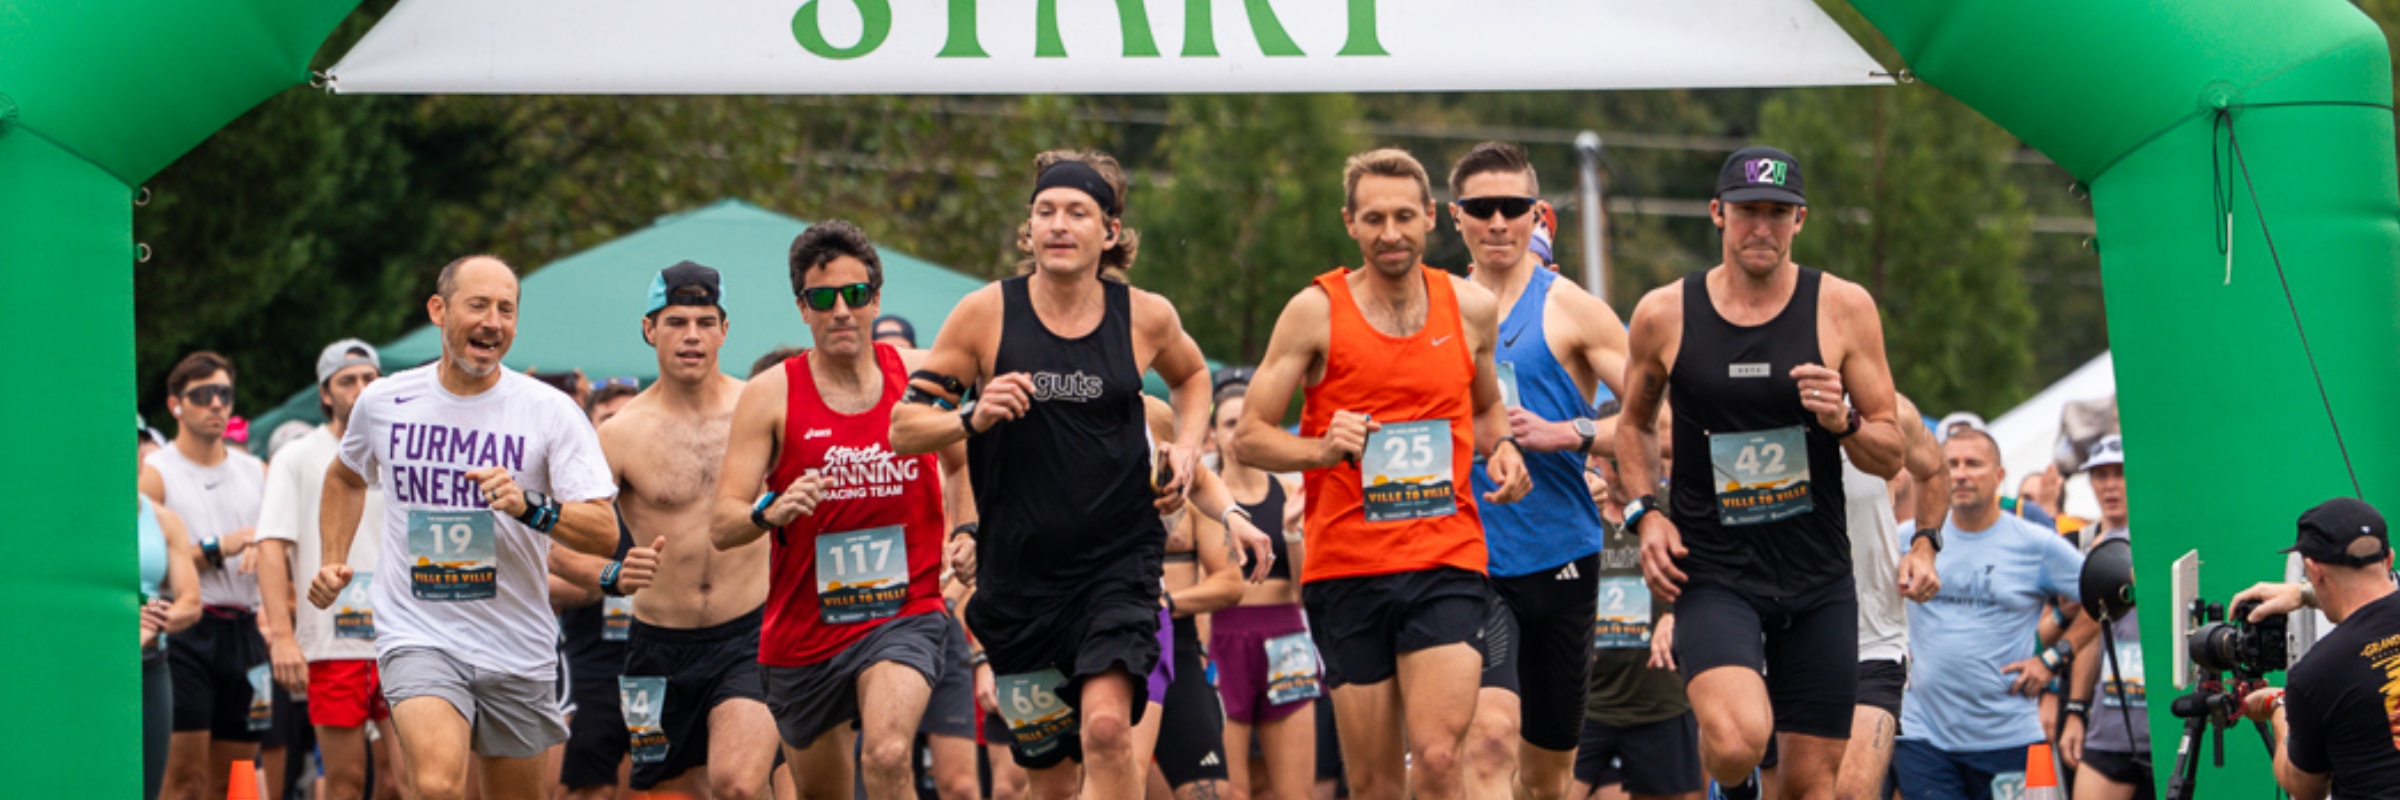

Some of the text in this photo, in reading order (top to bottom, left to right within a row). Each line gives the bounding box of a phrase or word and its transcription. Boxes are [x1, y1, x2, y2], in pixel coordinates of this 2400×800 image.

[1033, 370, 1103, 401] guts
[390, 422, 525, 472] FURMAN
[1383, 433, 1433, 471] 25
[1734, 442, 1786, 475] 42
[392, 465, 490, 509] ENER
[804, 458, 918, 488] NNING
[869, 484, 903, 498] TEAM
[429, 523, 473, 554] 19
[828, 539, 893, 576] 117
[1607, 587, 1625, 610] 2
[1012, 684, 1055, 714] 66
